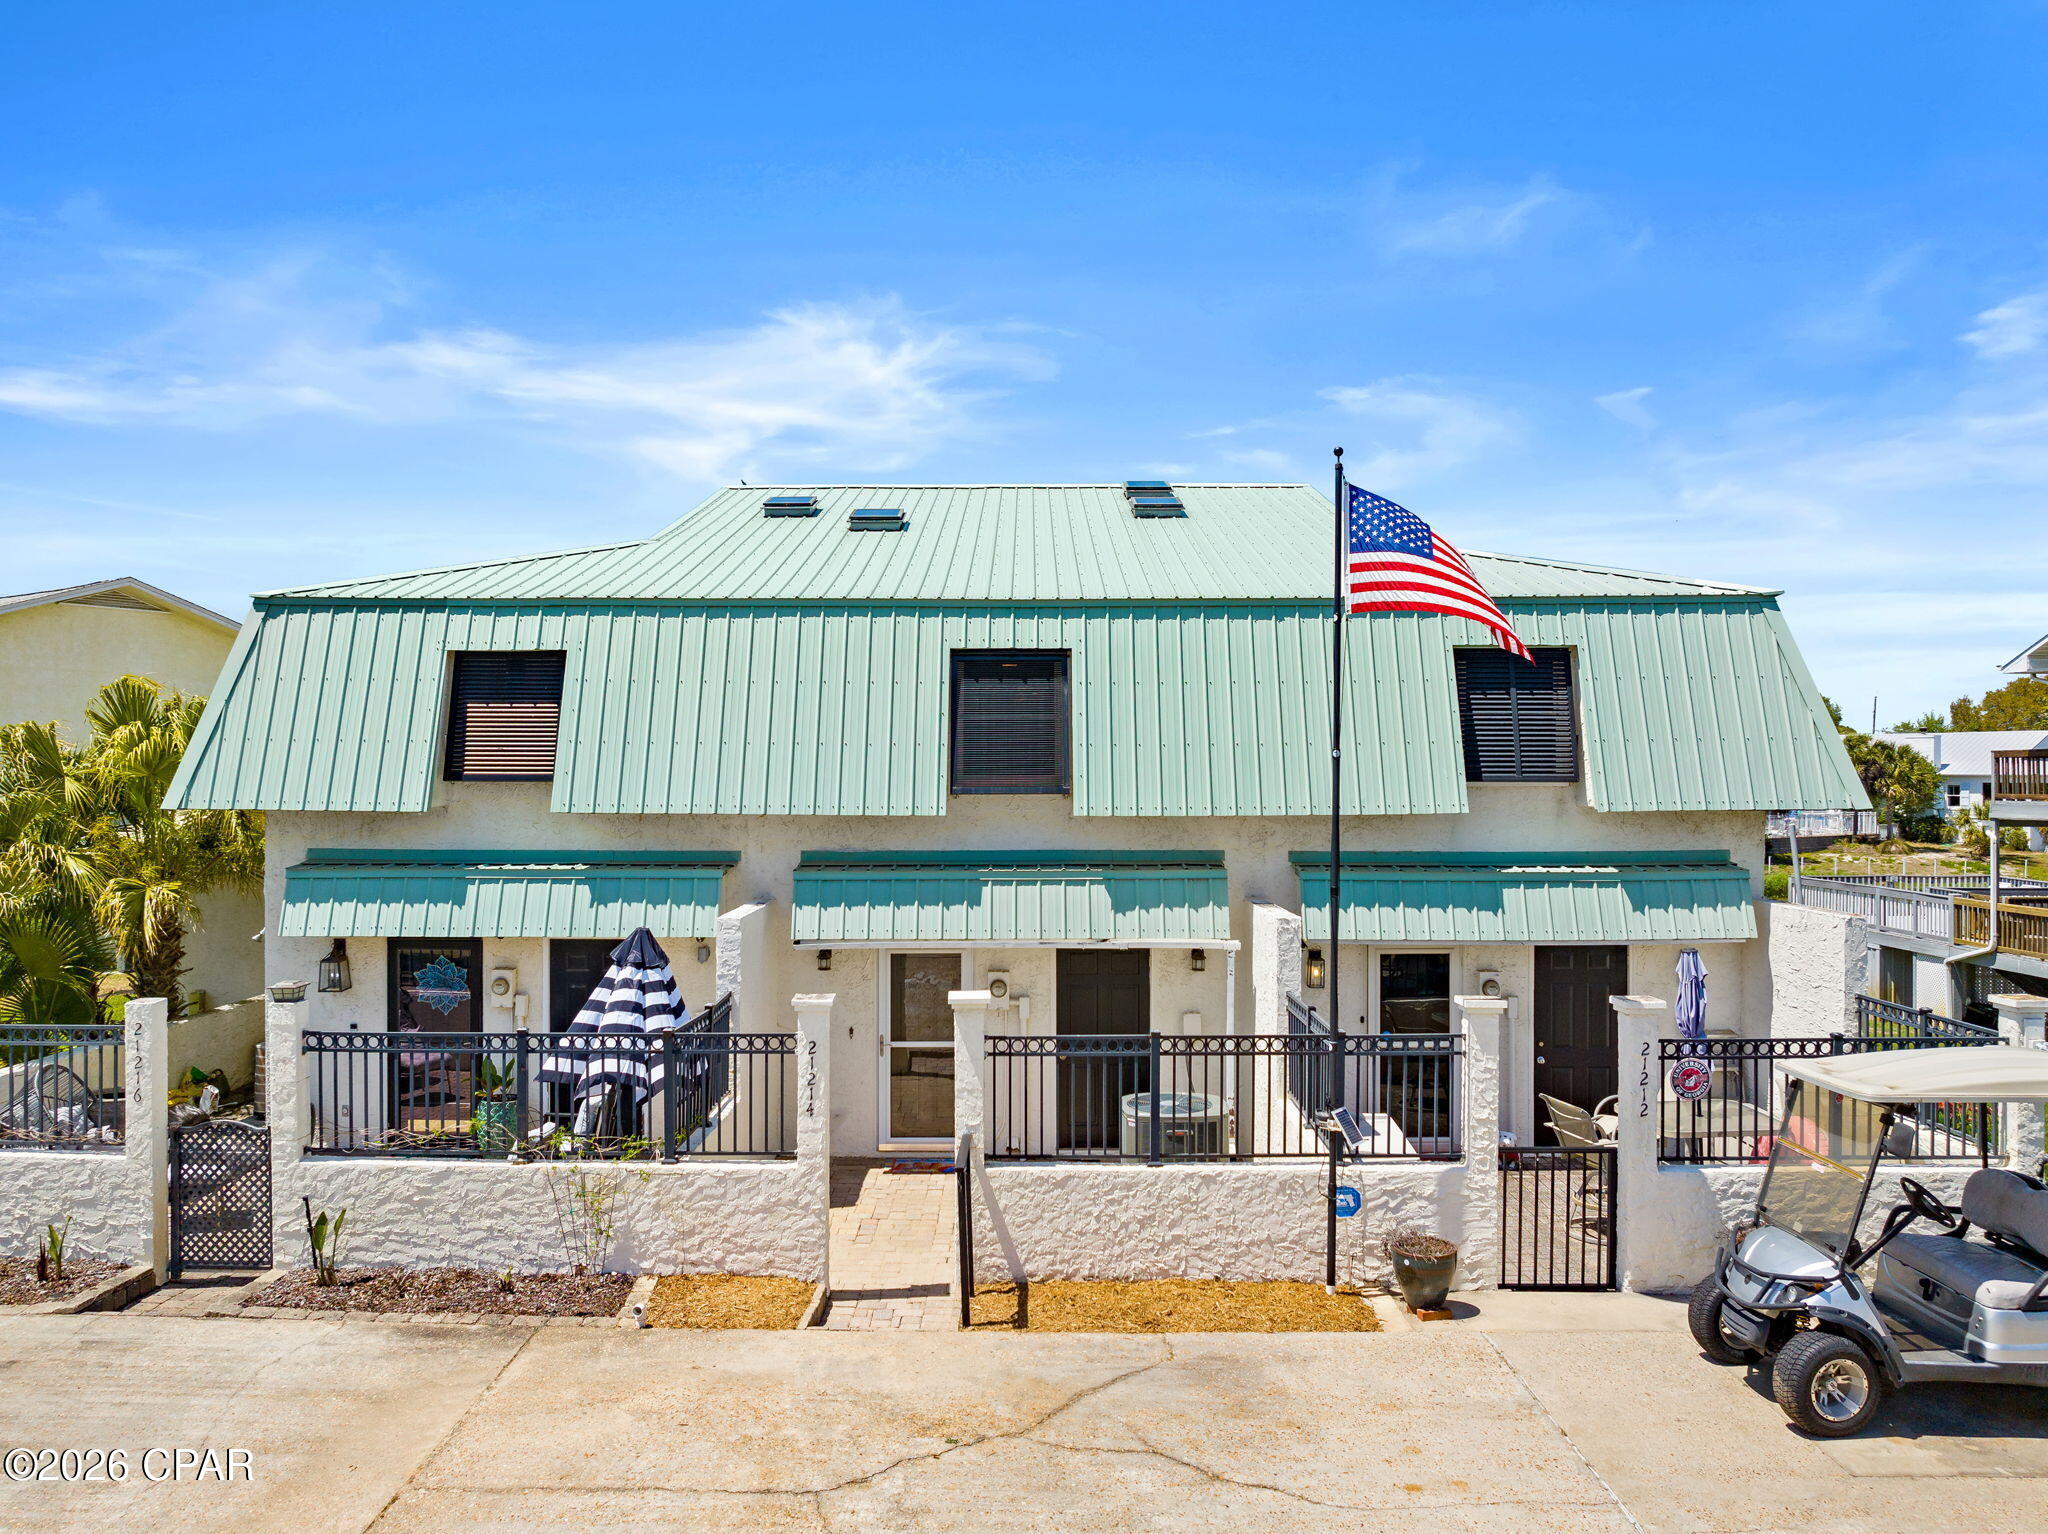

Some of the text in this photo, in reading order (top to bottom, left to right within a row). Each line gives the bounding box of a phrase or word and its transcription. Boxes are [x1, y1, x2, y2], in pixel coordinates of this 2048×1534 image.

[133, 1022, 143, 1103] 21216
[805, 1040, 817, 1118] 21214
[1639, 1041, 1651, 1118] 21212
[1673, 1061, 1708, 1078] UNIVERSITY
[1675, 1082, 1709, 1098] OF GEORGIA
